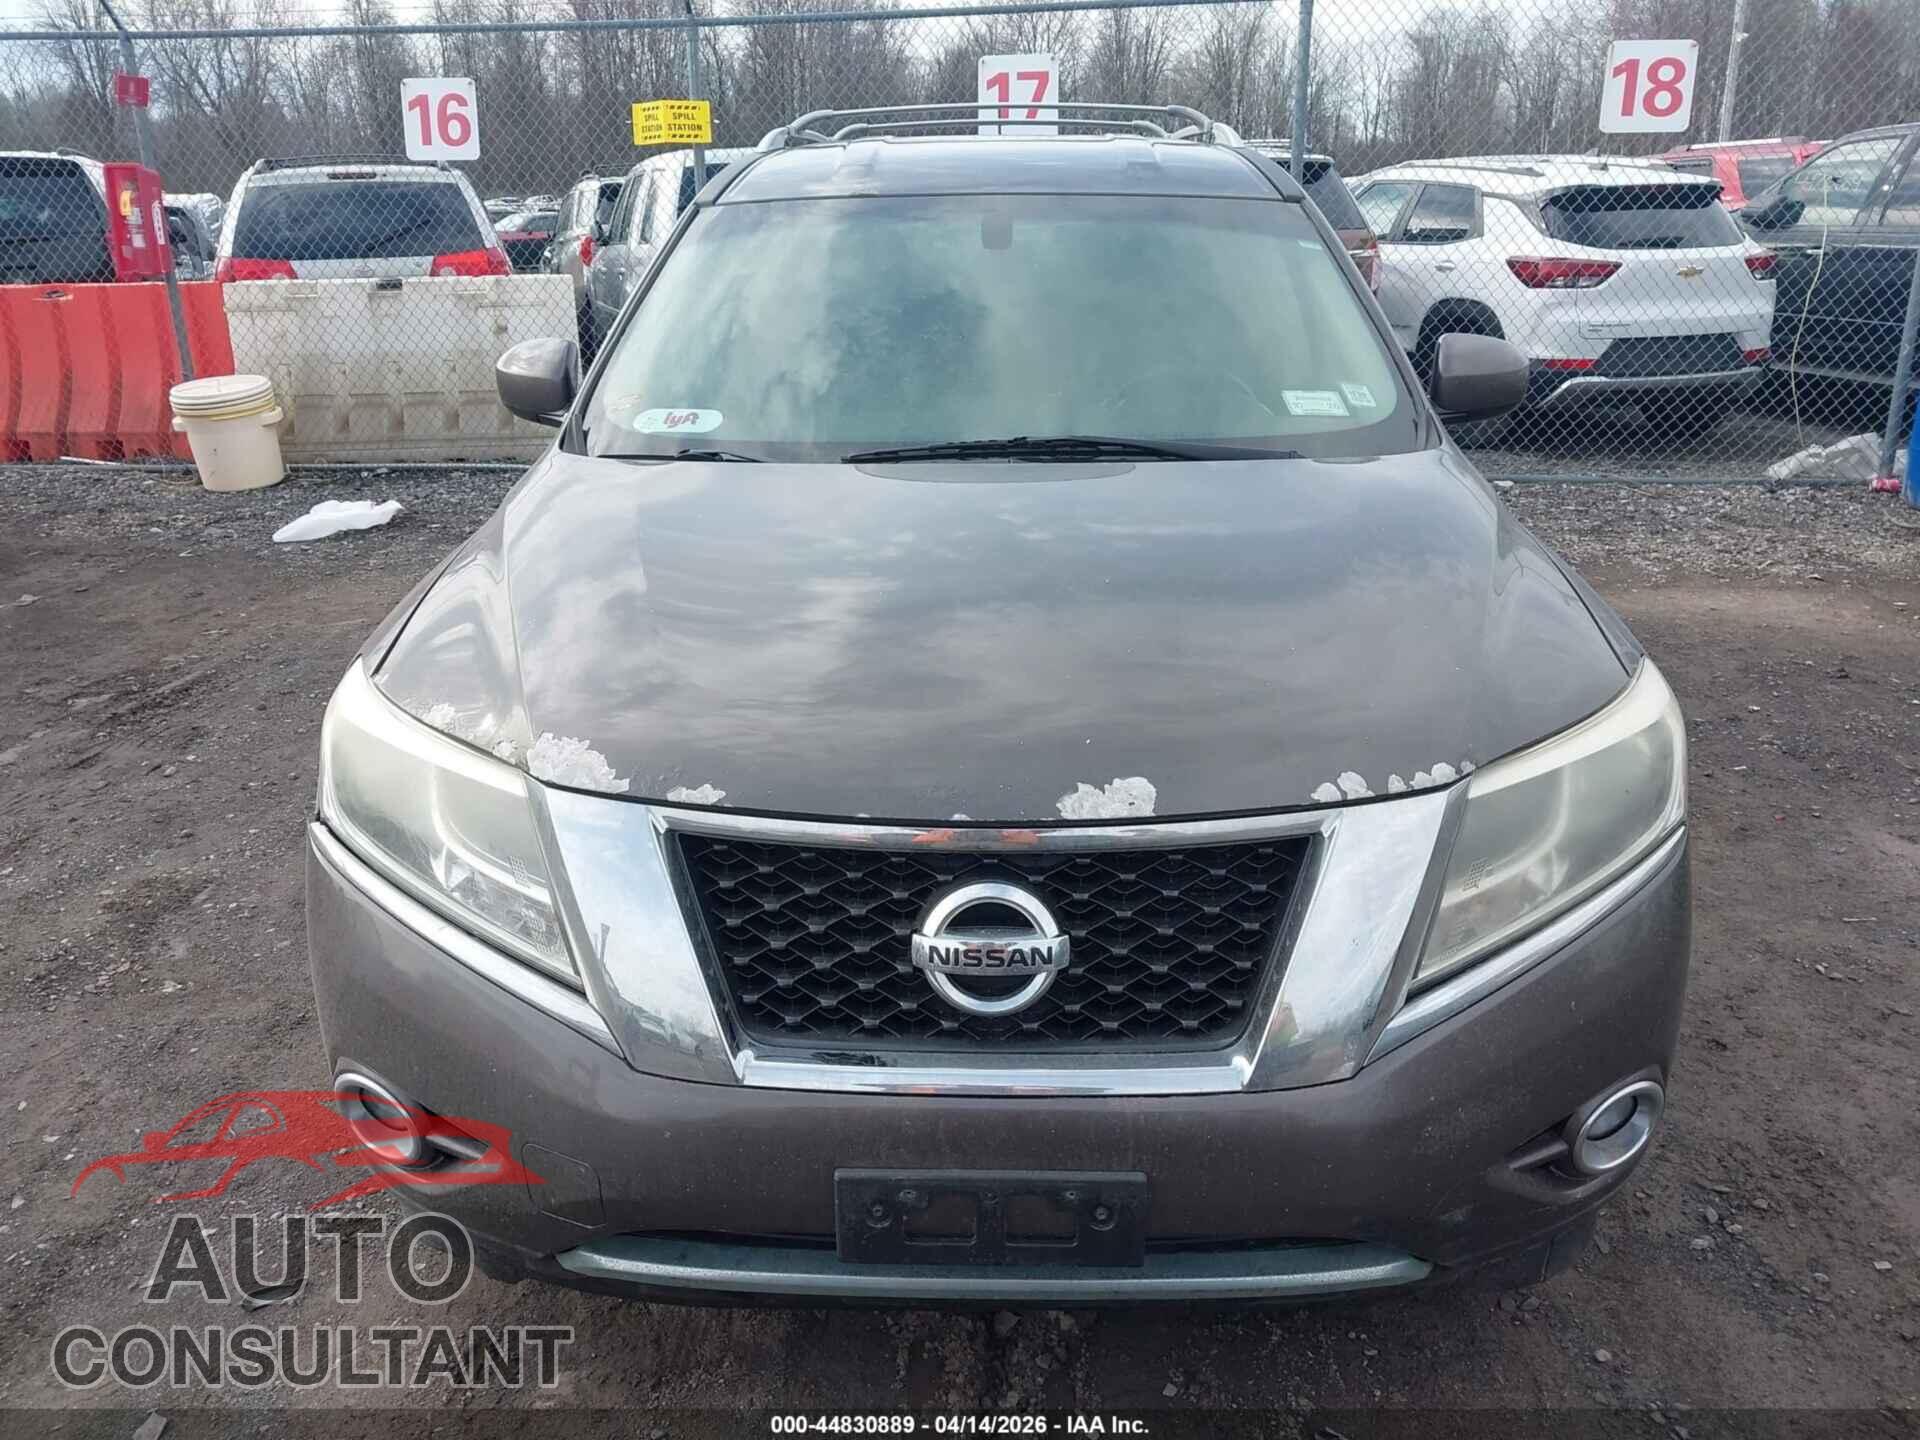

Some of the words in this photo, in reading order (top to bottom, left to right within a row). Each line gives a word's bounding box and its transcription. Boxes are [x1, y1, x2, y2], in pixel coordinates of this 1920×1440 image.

[986, 71, 1050, 119] 17
[1612, 57, 1687, 118] 18
[407, 92, 472, 147] 16
[667, 123, 703, 132] STATION
[672, 112, 696, 121] SPILL
[663, 411, 700, 429] lyft
[928, 945, 1053, 968] NISSAN
